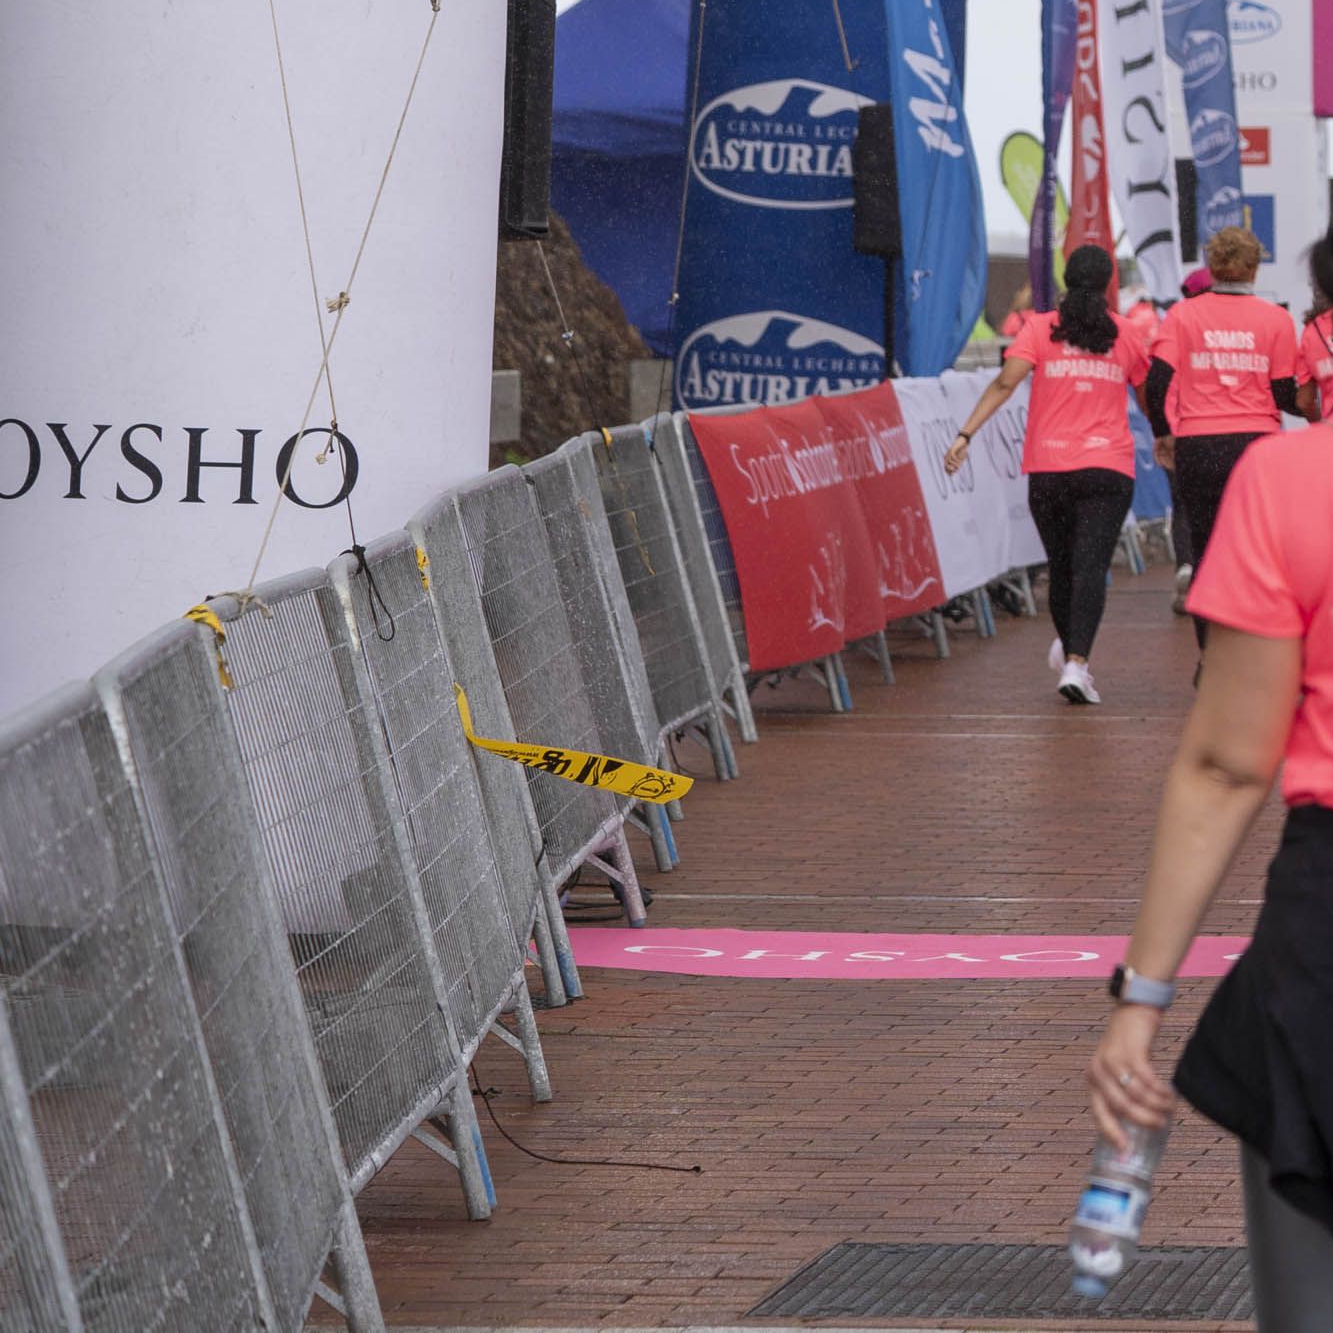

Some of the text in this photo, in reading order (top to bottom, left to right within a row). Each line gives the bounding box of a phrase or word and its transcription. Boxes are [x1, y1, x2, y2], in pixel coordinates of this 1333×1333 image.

[727, 120, 806, 138] CENTRAL
[699, 121, 854, 176] ASTURIA
[709, 350, 881, 372] CENTRAL LECHERA
[0, 419, 359, 509] OYSHO
